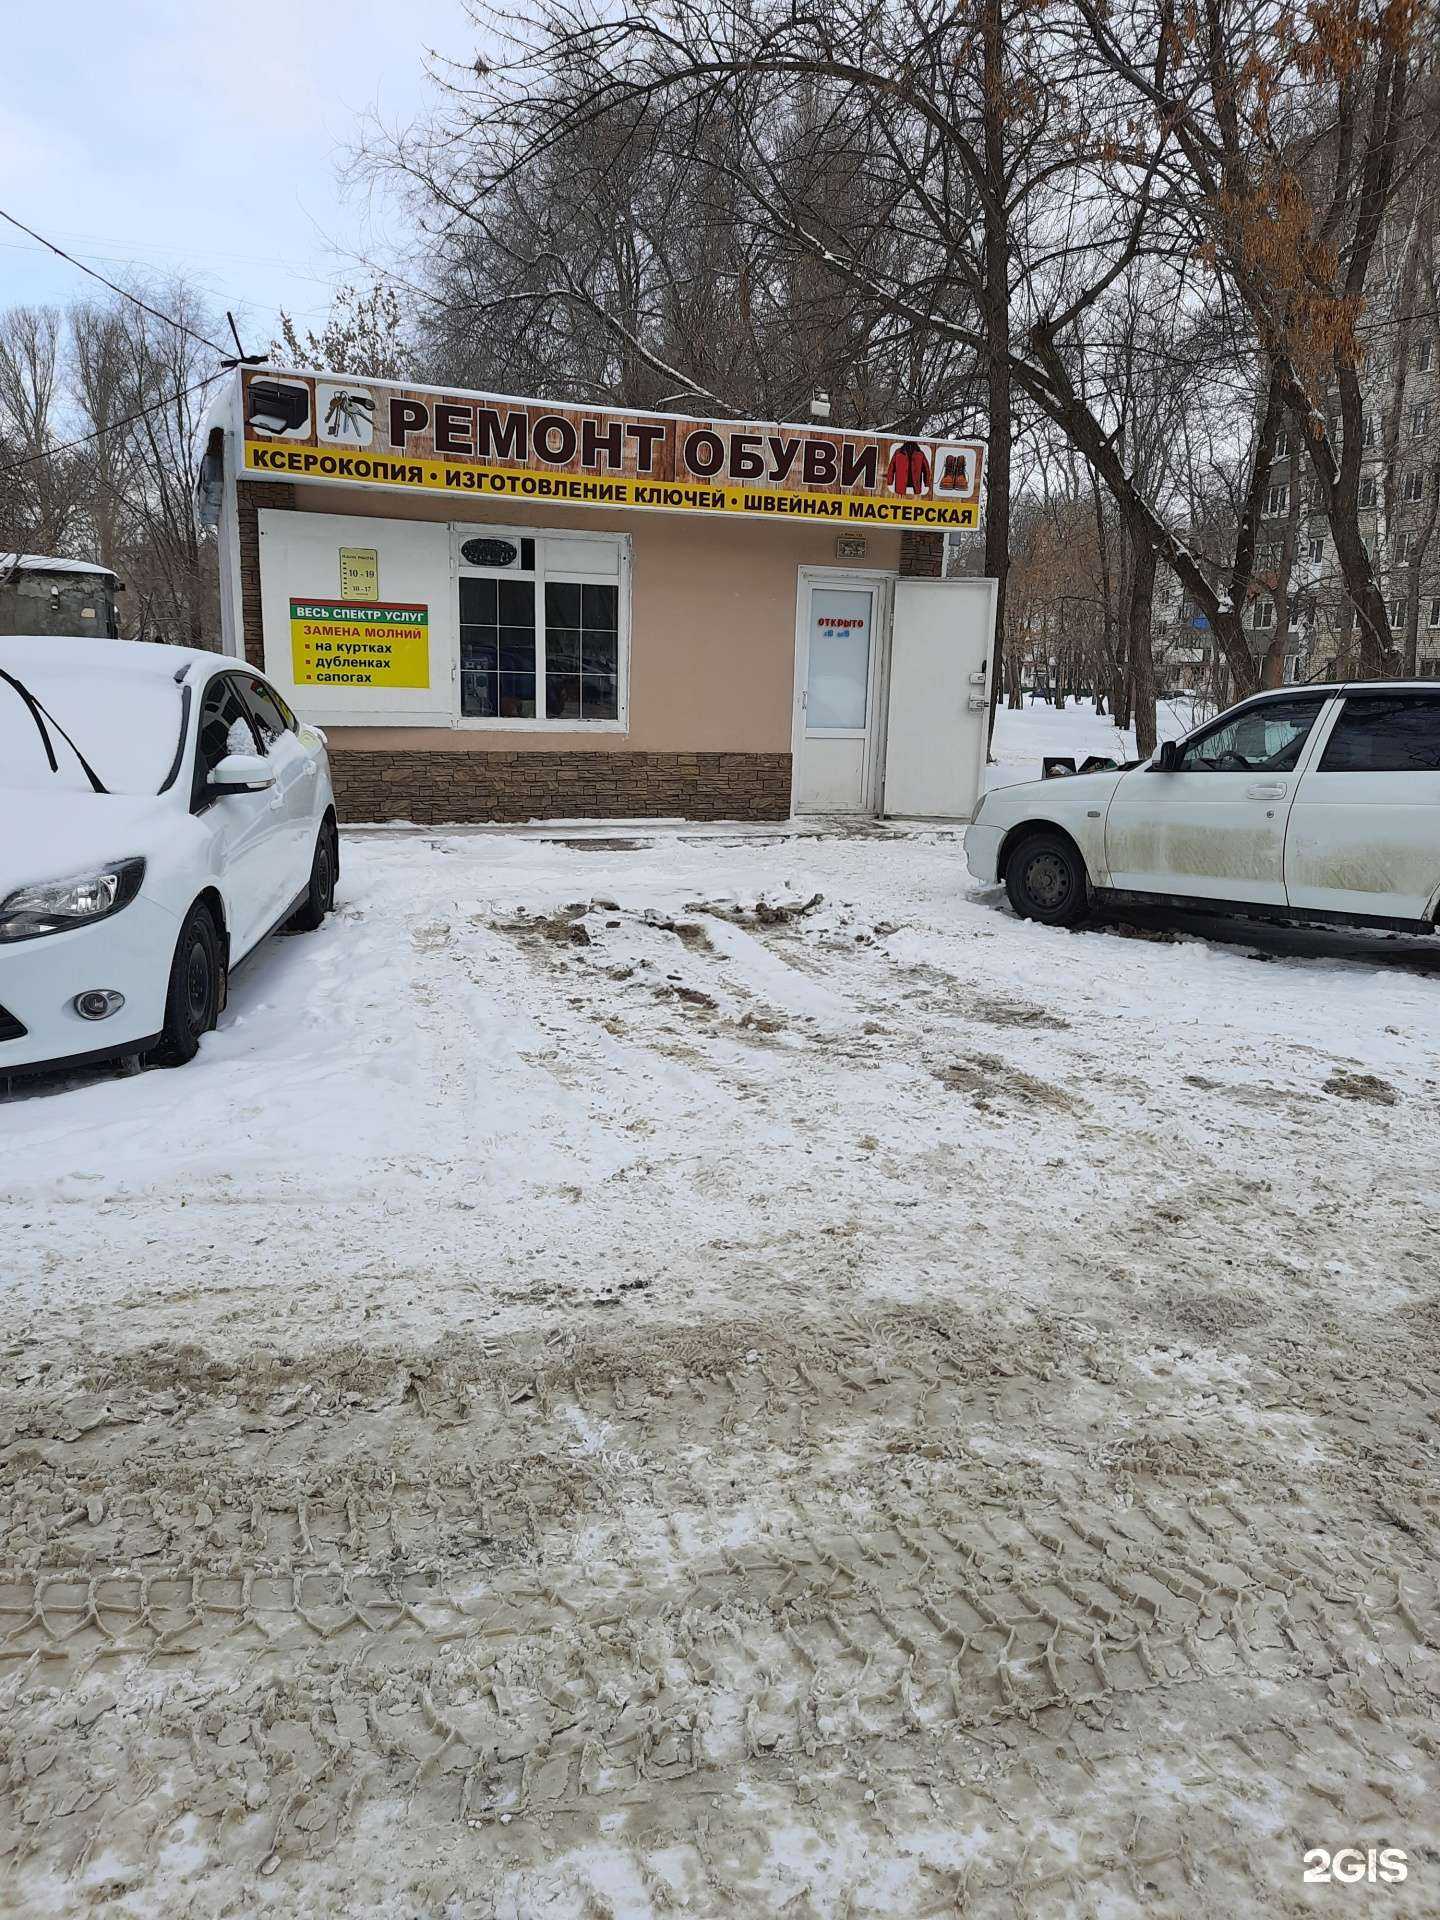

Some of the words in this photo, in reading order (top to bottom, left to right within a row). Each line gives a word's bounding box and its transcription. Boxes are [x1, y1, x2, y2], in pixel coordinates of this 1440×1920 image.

[388, 397, 666, 473] РЕМОНТ
[683, 429, 880, 490] ОБУВИ
[253, 449, 423, 483] КСЕРОКОПИЯ
[445, 470, 627, 502] ИЗГОТОВЛЕНИЕ
[634, 488, 726, 510] КЛЮЧЕЙ
[744, 493, 843, 517] ШВЕЙНАЯ
[849, 502, 973, 525] МАСТЕРСКАЯ
[349, 569, 359, 578] 10
[296, 607, 329, 618] ВЕСЬ
[333, 609, 381, 620] СПЕКТР
[385, 611, 424, 622] УСЛУГ
[818, 617, 864, 628] ОТКРЫТО
[303, 625, 361, 637] ЗАМЕНА
[365, 627, 422, 639] МОЛНИЙ
[315, 641, 332, 651] на
[336, 643, 393, 655] куртках
[315, 656, 391, 669] дубленках
[316, 671, 372, 683] сапогах
